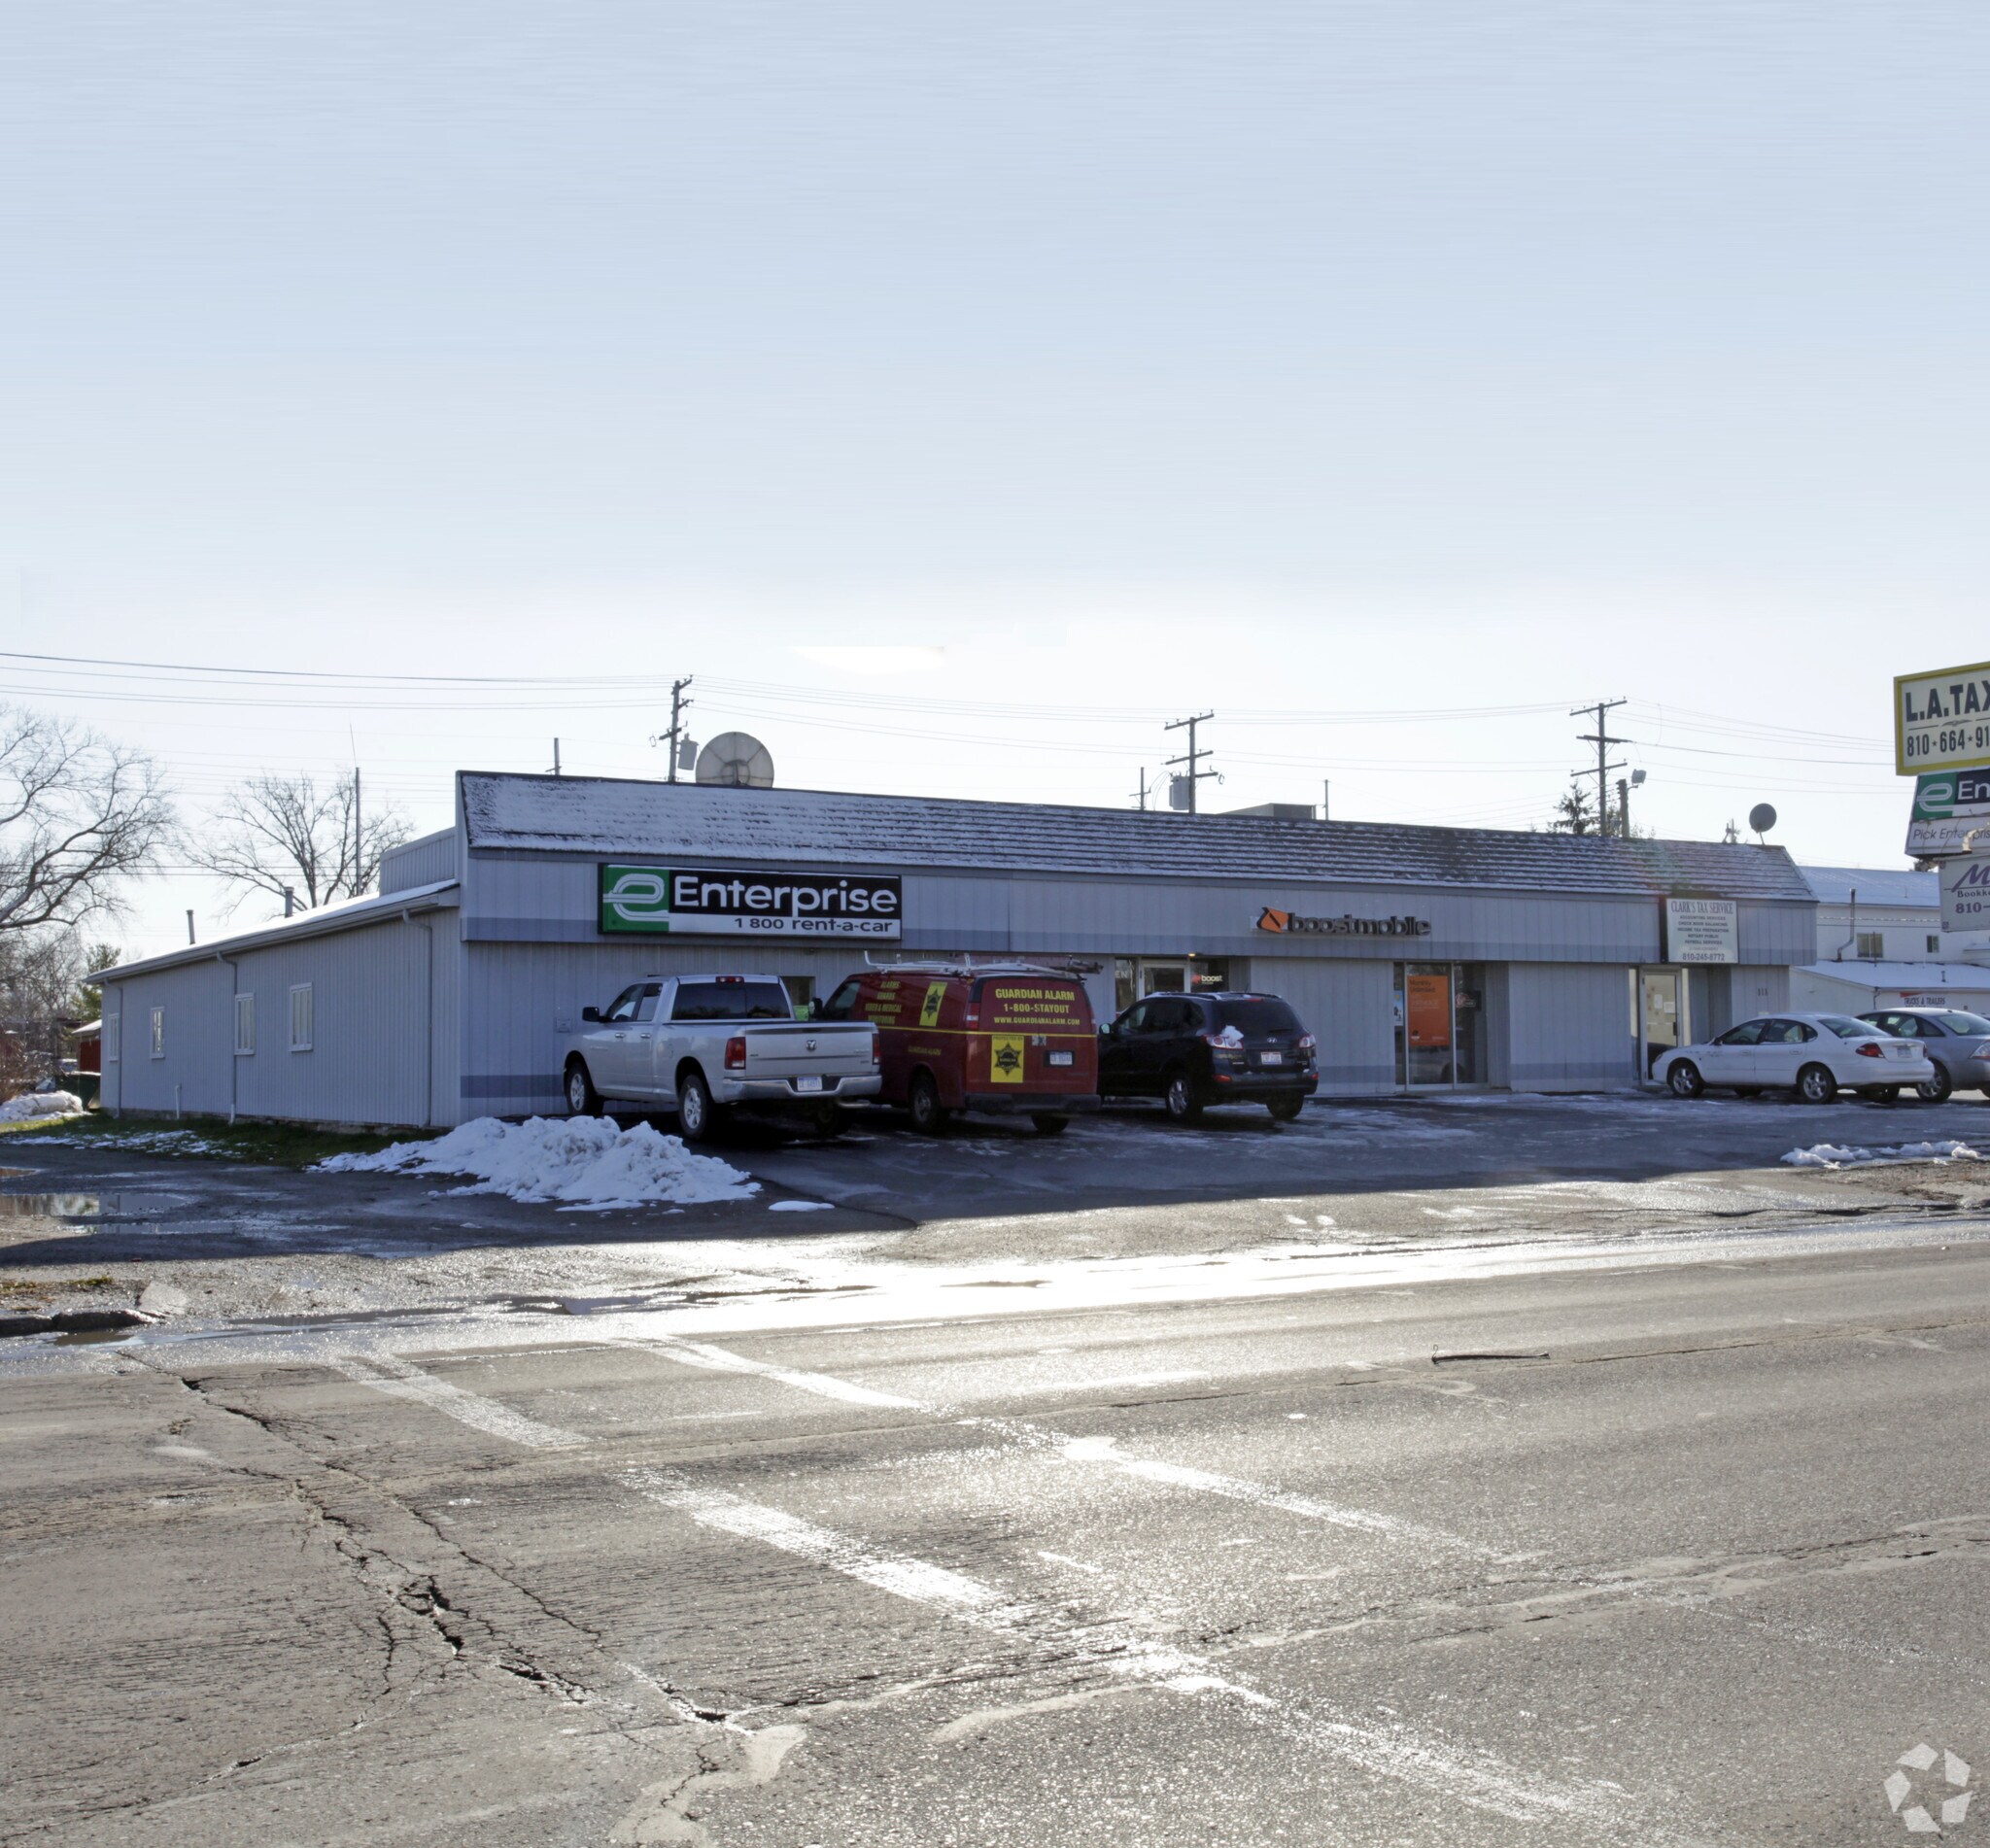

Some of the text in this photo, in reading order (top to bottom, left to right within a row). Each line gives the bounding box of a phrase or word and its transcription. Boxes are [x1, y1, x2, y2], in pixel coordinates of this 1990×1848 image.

[1913, 829, 1937, 840] Pick
[674, 875, 897, 917] Enterprise
[1671, 901, 1733, 914] CLARK'S TAX SERVICE
[735, 918, 892, 932] 1 800 rent-a-car
[995, 988, 1075, 1001] GUARDIAN ALARM
[1004, 1003, 1070, 1013] 1-800-STAYOUT
